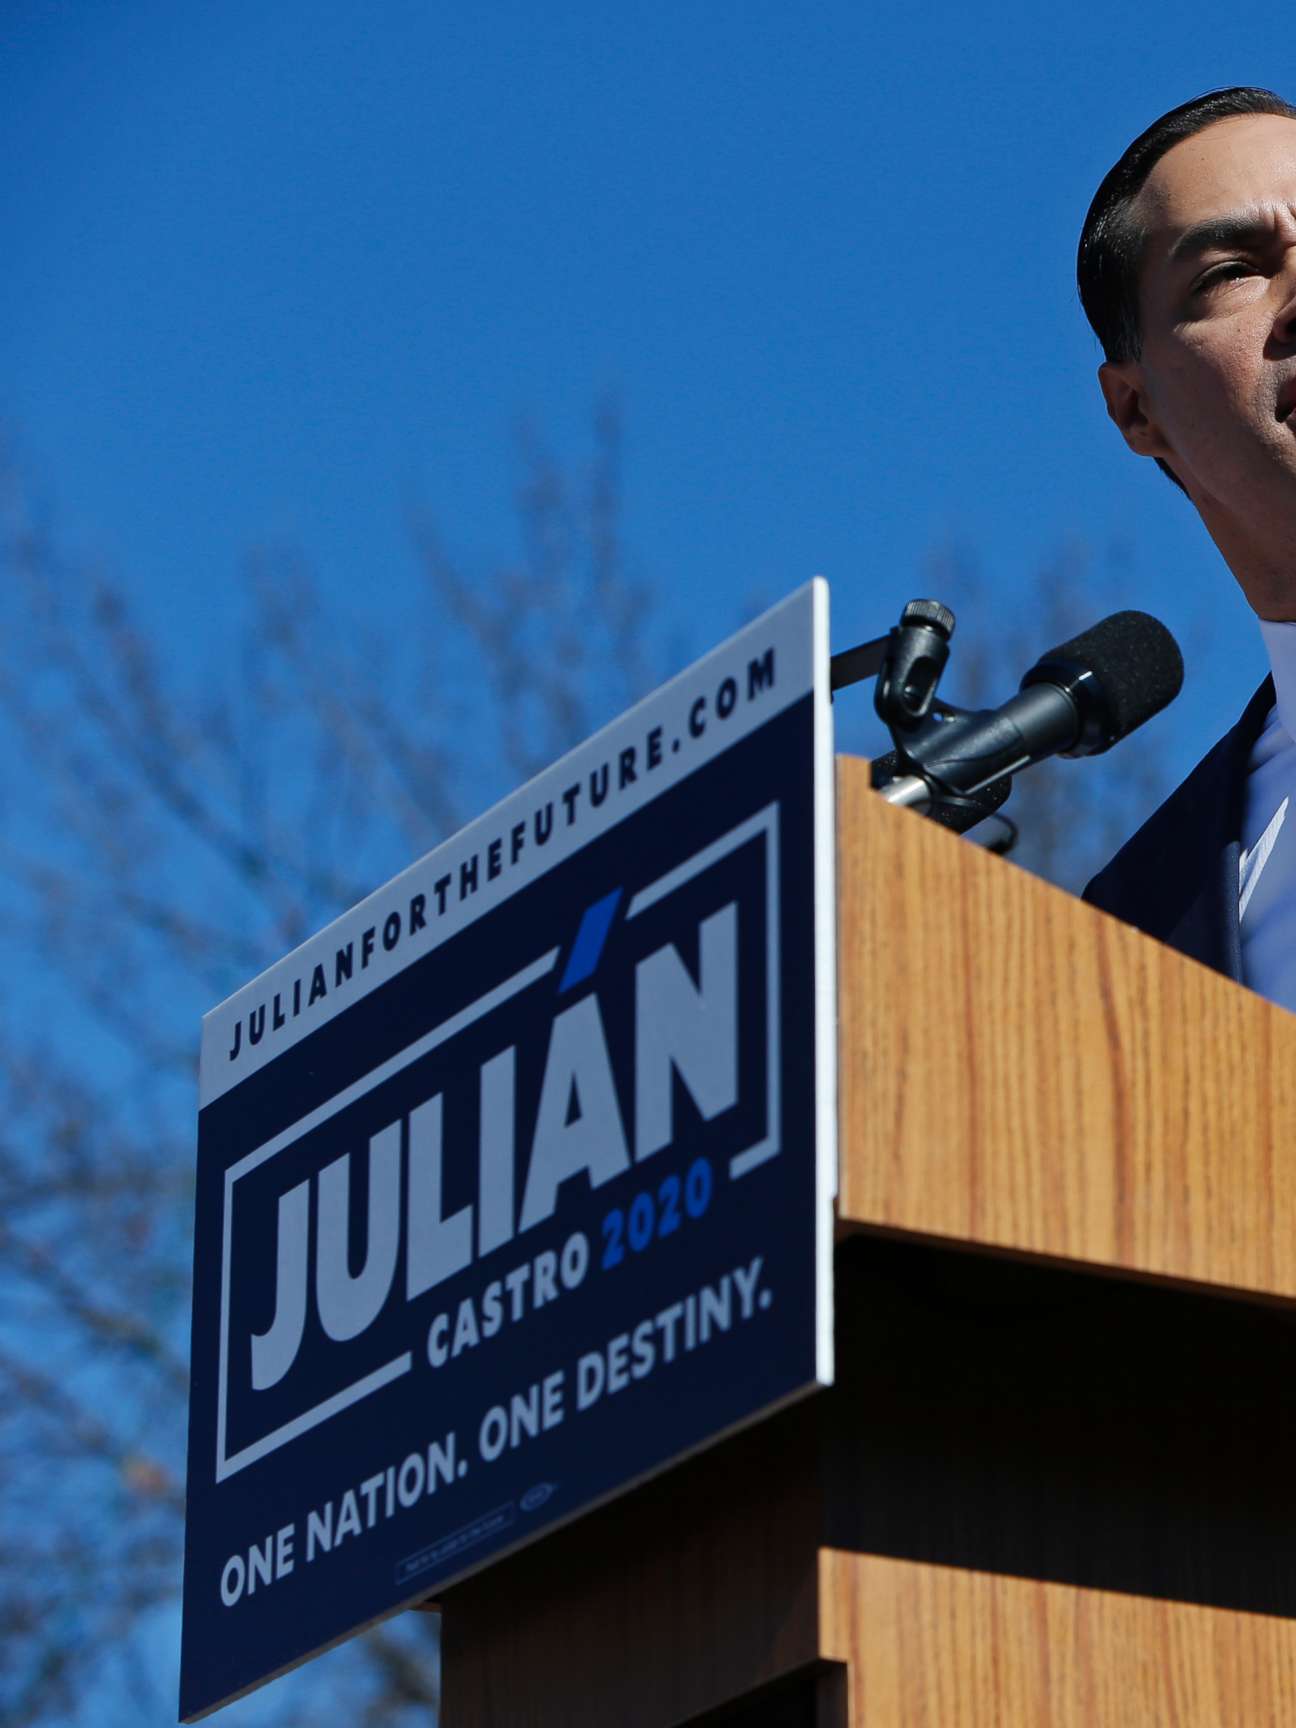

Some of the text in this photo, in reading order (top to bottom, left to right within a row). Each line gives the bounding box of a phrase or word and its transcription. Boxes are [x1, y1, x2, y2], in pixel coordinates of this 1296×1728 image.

[228, 647, 776, 1061] JULIANFORTHEFUTURE.COM
[251, 886, 738, 1391] JULIÁN
[426, 1157, 713, 1368] CASTRO 2020
[219, 1524, 295, 1608] ONE
[305, 1432, 469, 1563] NATION.
[478, 1371, 565, 1462] ONE
[576, 1256, 773, 1411] DESTINY.
